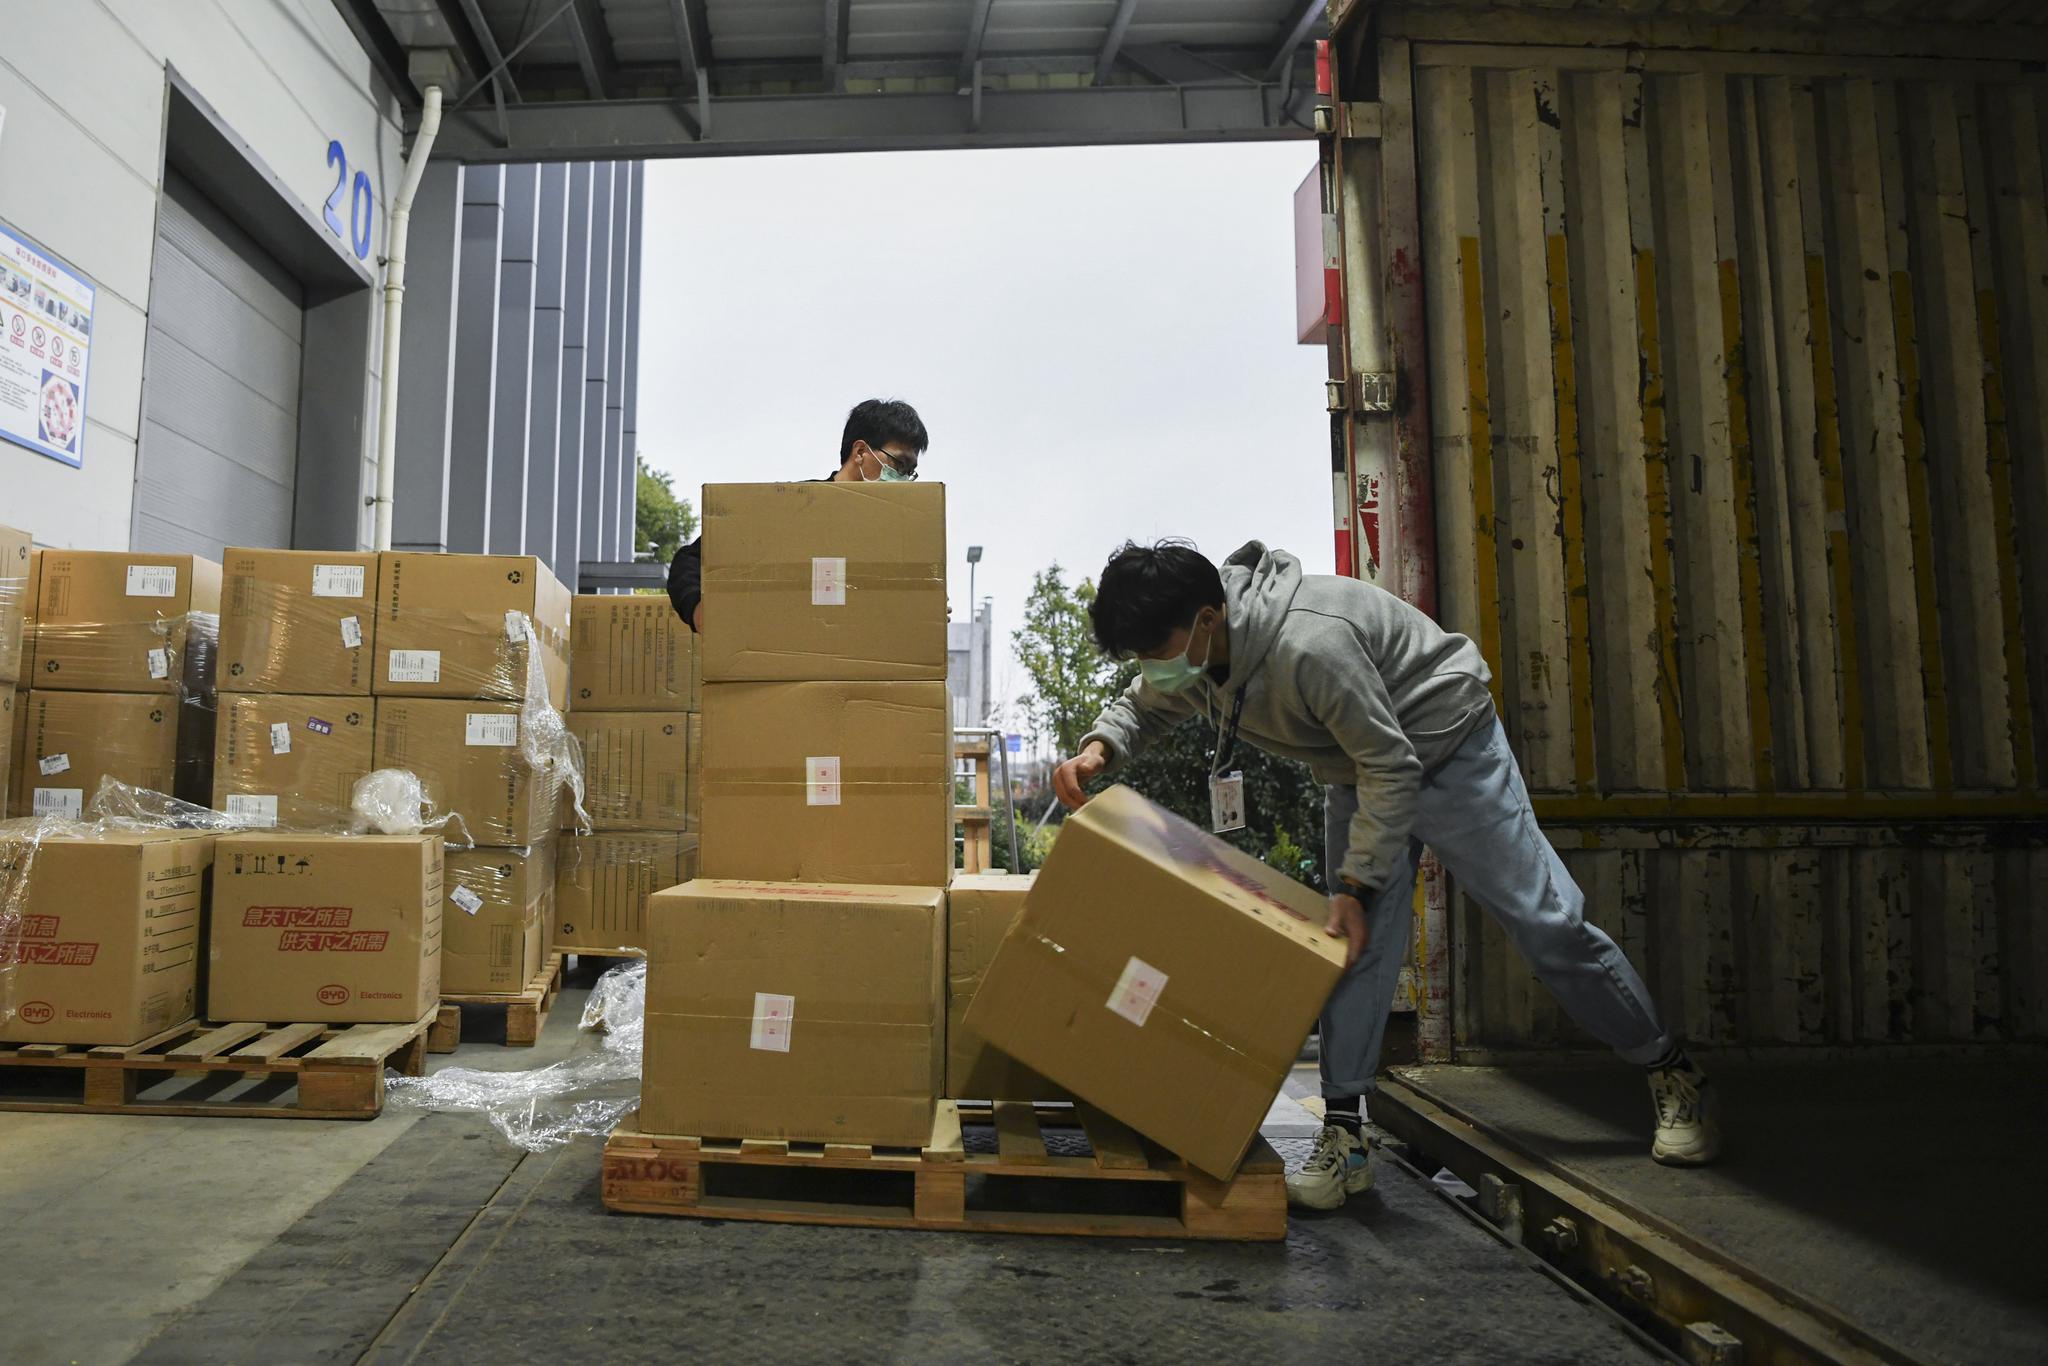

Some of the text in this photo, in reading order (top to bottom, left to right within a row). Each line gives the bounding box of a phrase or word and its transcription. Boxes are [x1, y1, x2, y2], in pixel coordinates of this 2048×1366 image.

[323, 140, 372, 260] 20
[244, 907, 351, 926] 急天下之所急
[280, 931, 387, 950] 供天下之所需
[320, 990, 402, 1000] BYD Electronics
[24, 1007, 112, 1019] BYD Electronics
